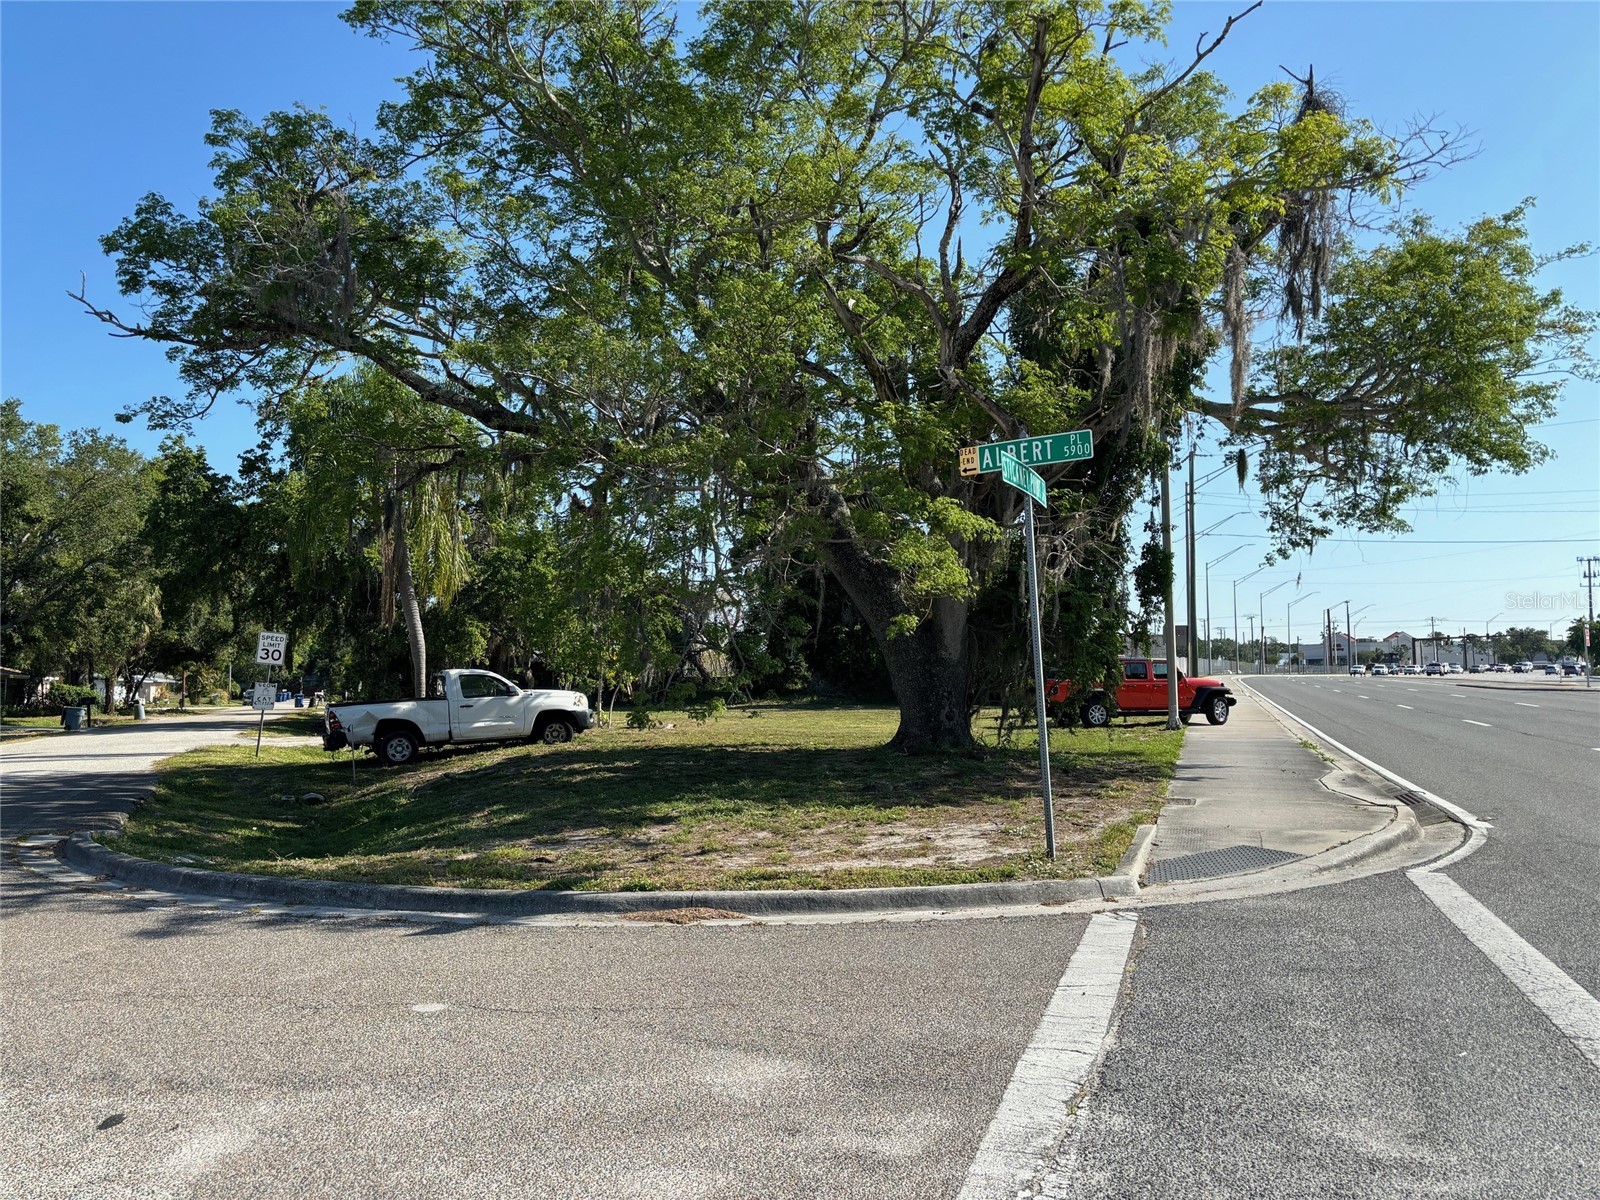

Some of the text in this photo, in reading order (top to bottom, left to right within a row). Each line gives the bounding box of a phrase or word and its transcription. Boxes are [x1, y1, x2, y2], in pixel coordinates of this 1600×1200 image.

[1070, 433, 1083, 445] PL
[960, 447, 977, 456] DEAD
[983, 439, 1053, 469] ALBERT
[1063, 442, 1091, 457] 5900
[962, 457, 975, 465] END
[261, 635, 284, 643] SPEED
[259, 648, 282, 661] 30
